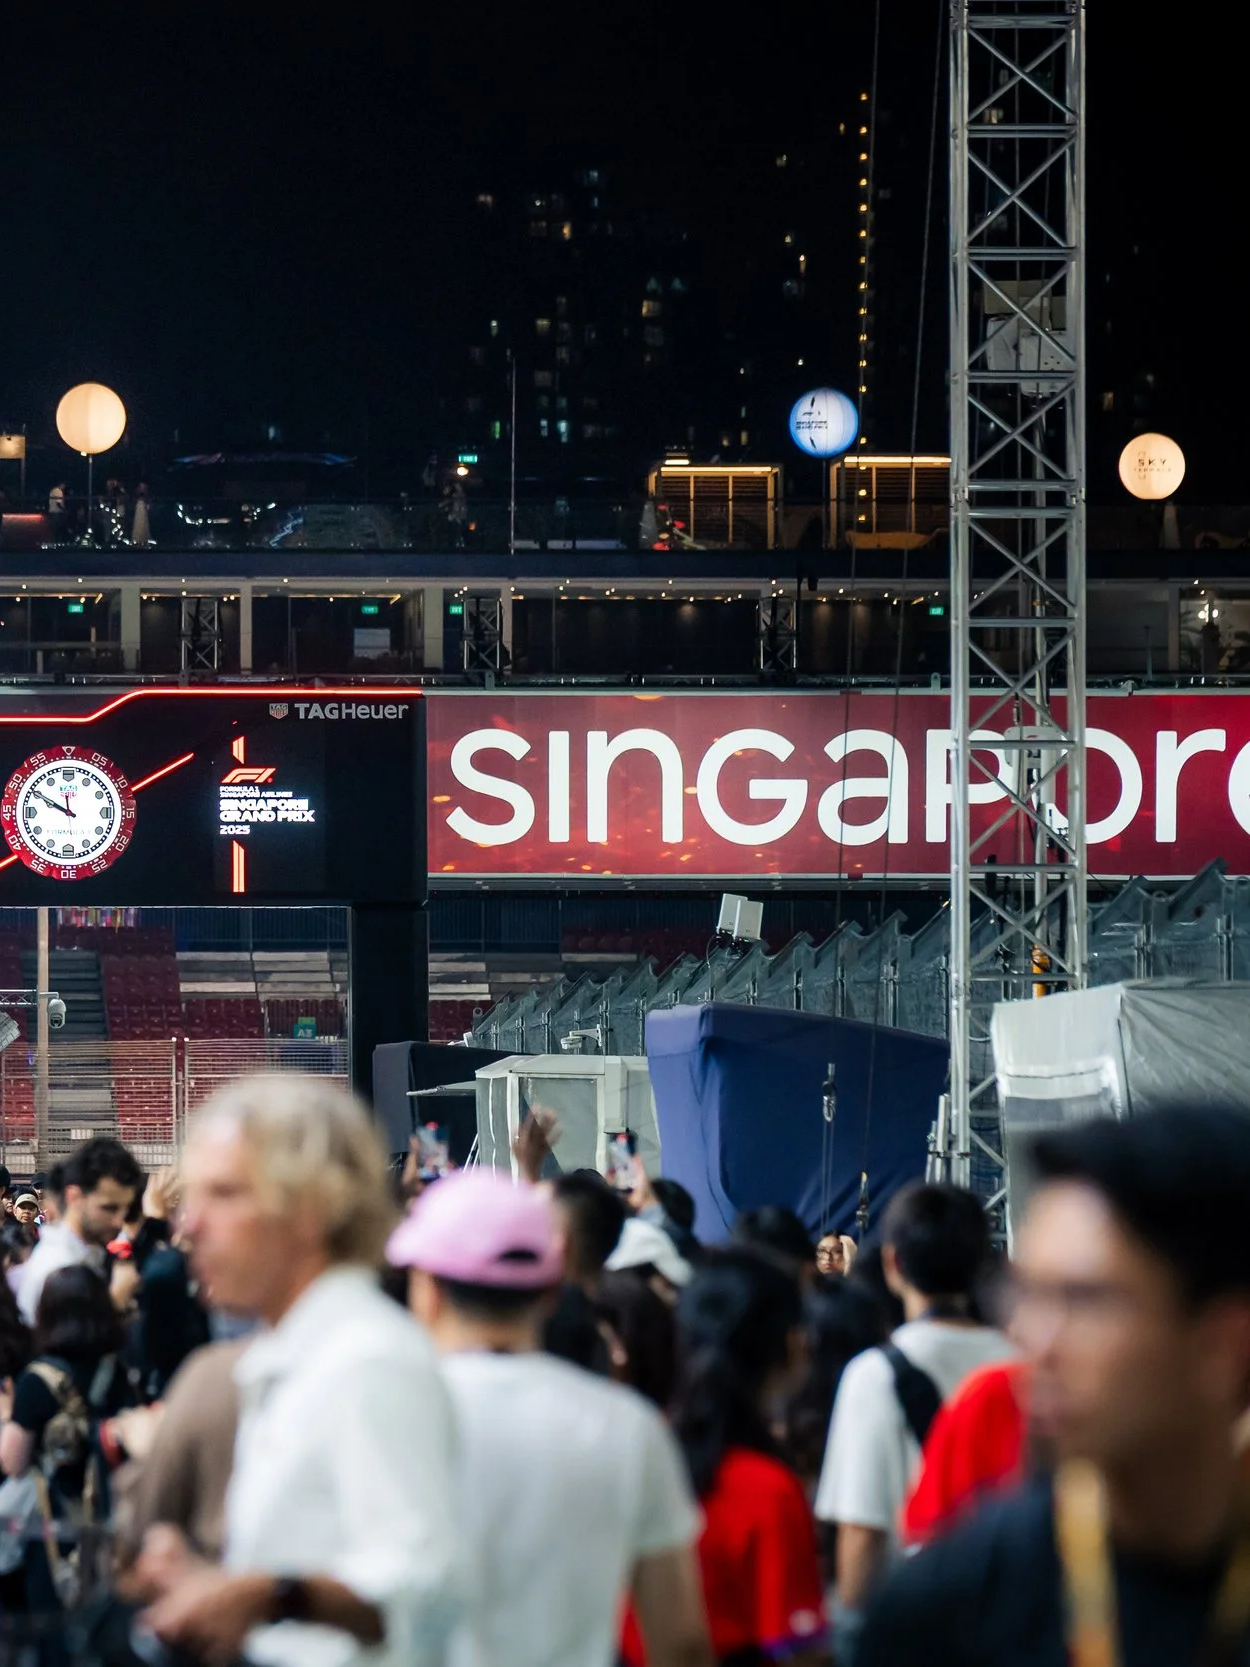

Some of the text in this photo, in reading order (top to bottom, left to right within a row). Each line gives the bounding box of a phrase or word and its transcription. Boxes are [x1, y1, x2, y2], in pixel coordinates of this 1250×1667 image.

[1138, 458, 1167, 466] SKY
[29, 752, 46, 766] 55
[91, 752, 108, 766] 05
[10, 773, 23, 790] 50
[116, 775, 128, 789] 10
[219, 799, 309, 810] SINGAPORE
[2, 805, 12, 821] 45
[126, 807, 135, 819] 15
[219, 810, 315, 822] GRAND PRIX
[219, 825, 251, 835] 2025
[8, 834, 21, 851] 40
[115, 835, 130, 852] 20
[30, 859, 46, 873] 35
[91, 859, 108, 873] 25
[60, 870, 77, 879] 30
[297, 1029, 312, 1038] A3
